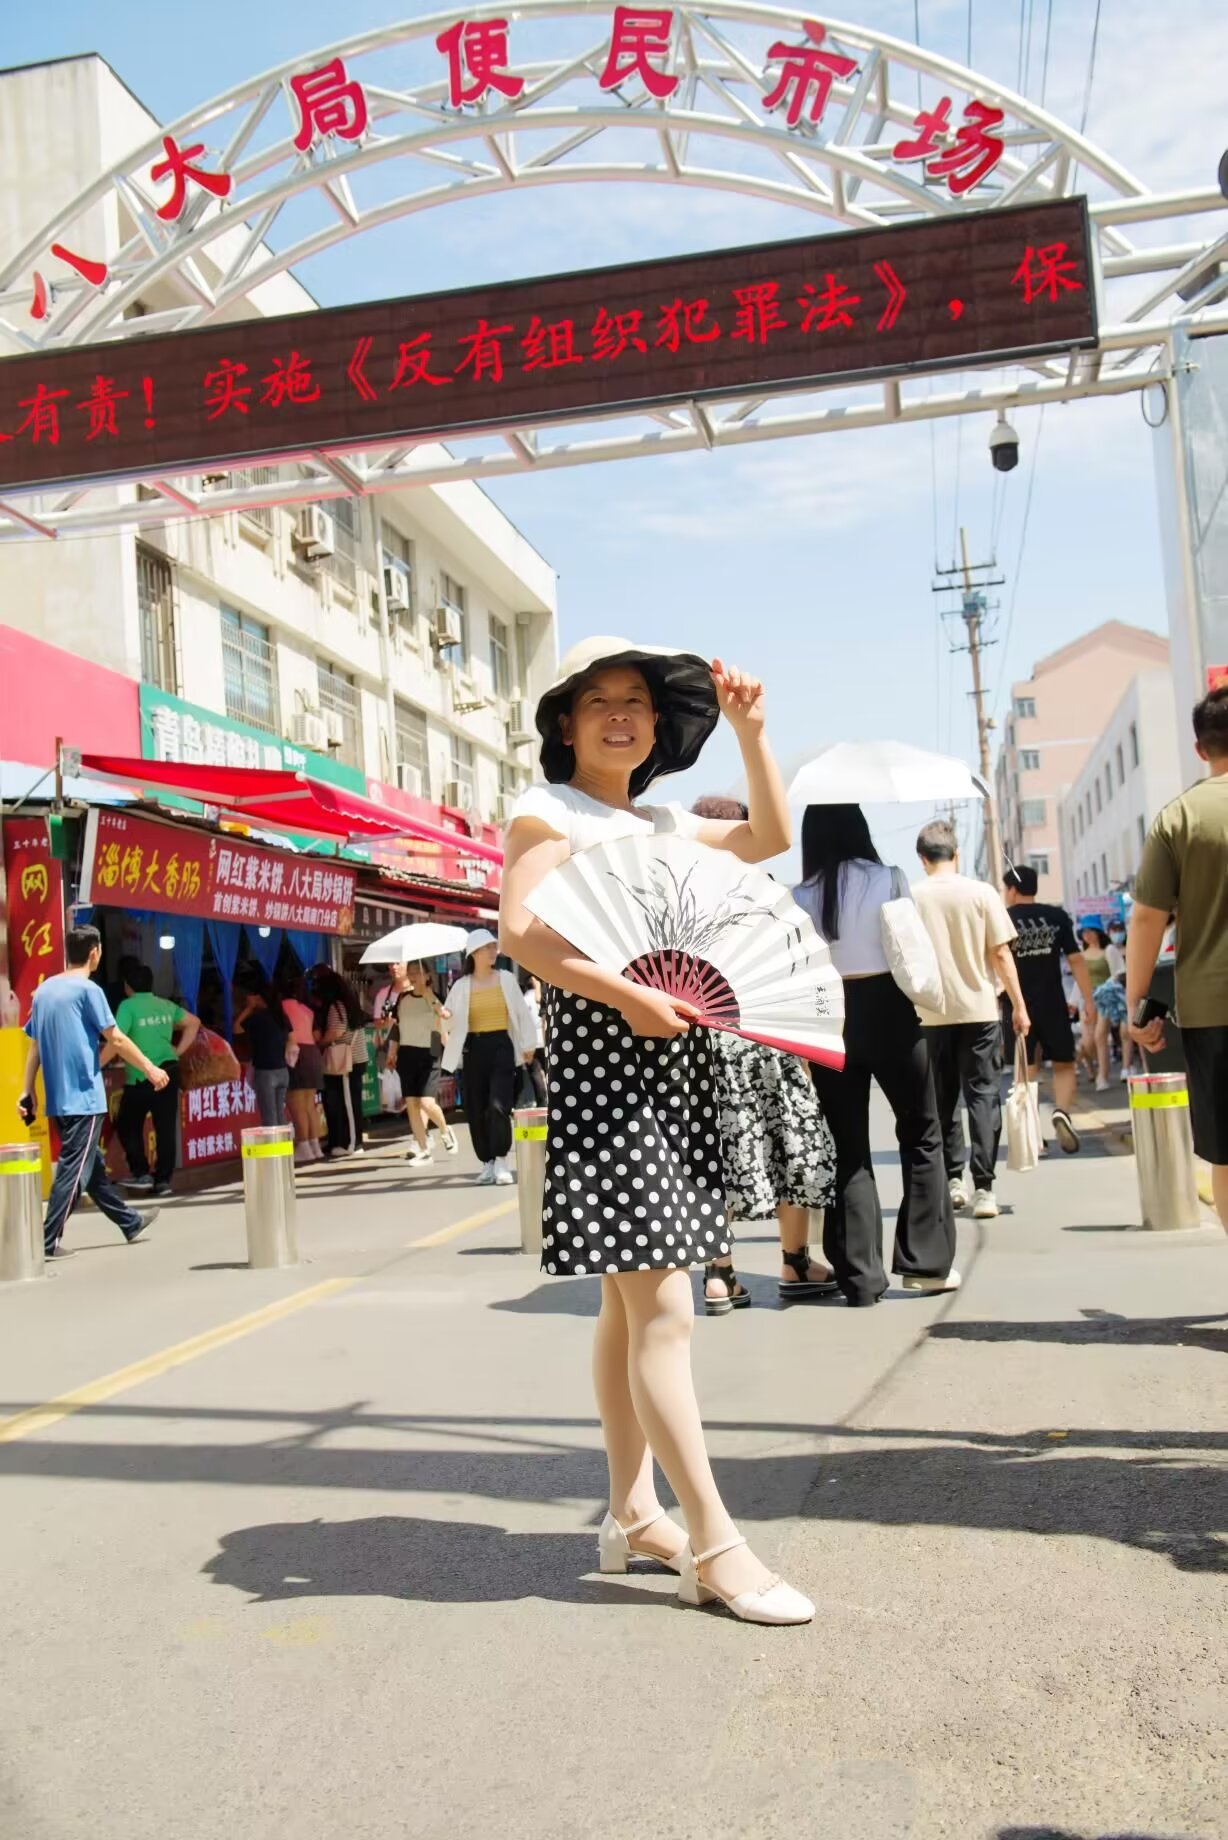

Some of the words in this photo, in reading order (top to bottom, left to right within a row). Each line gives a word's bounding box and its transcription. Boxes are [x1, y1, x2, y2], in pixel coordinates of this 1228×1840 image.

[30, 7, 1005, 319] 八大局便民市场
[0, 243, 1083, 444] 有责！实施《反有组织犯罪法》，保
[21, 863, 53, 1002] 网红
[98, 842, 201, 899] 淄博大香肠
